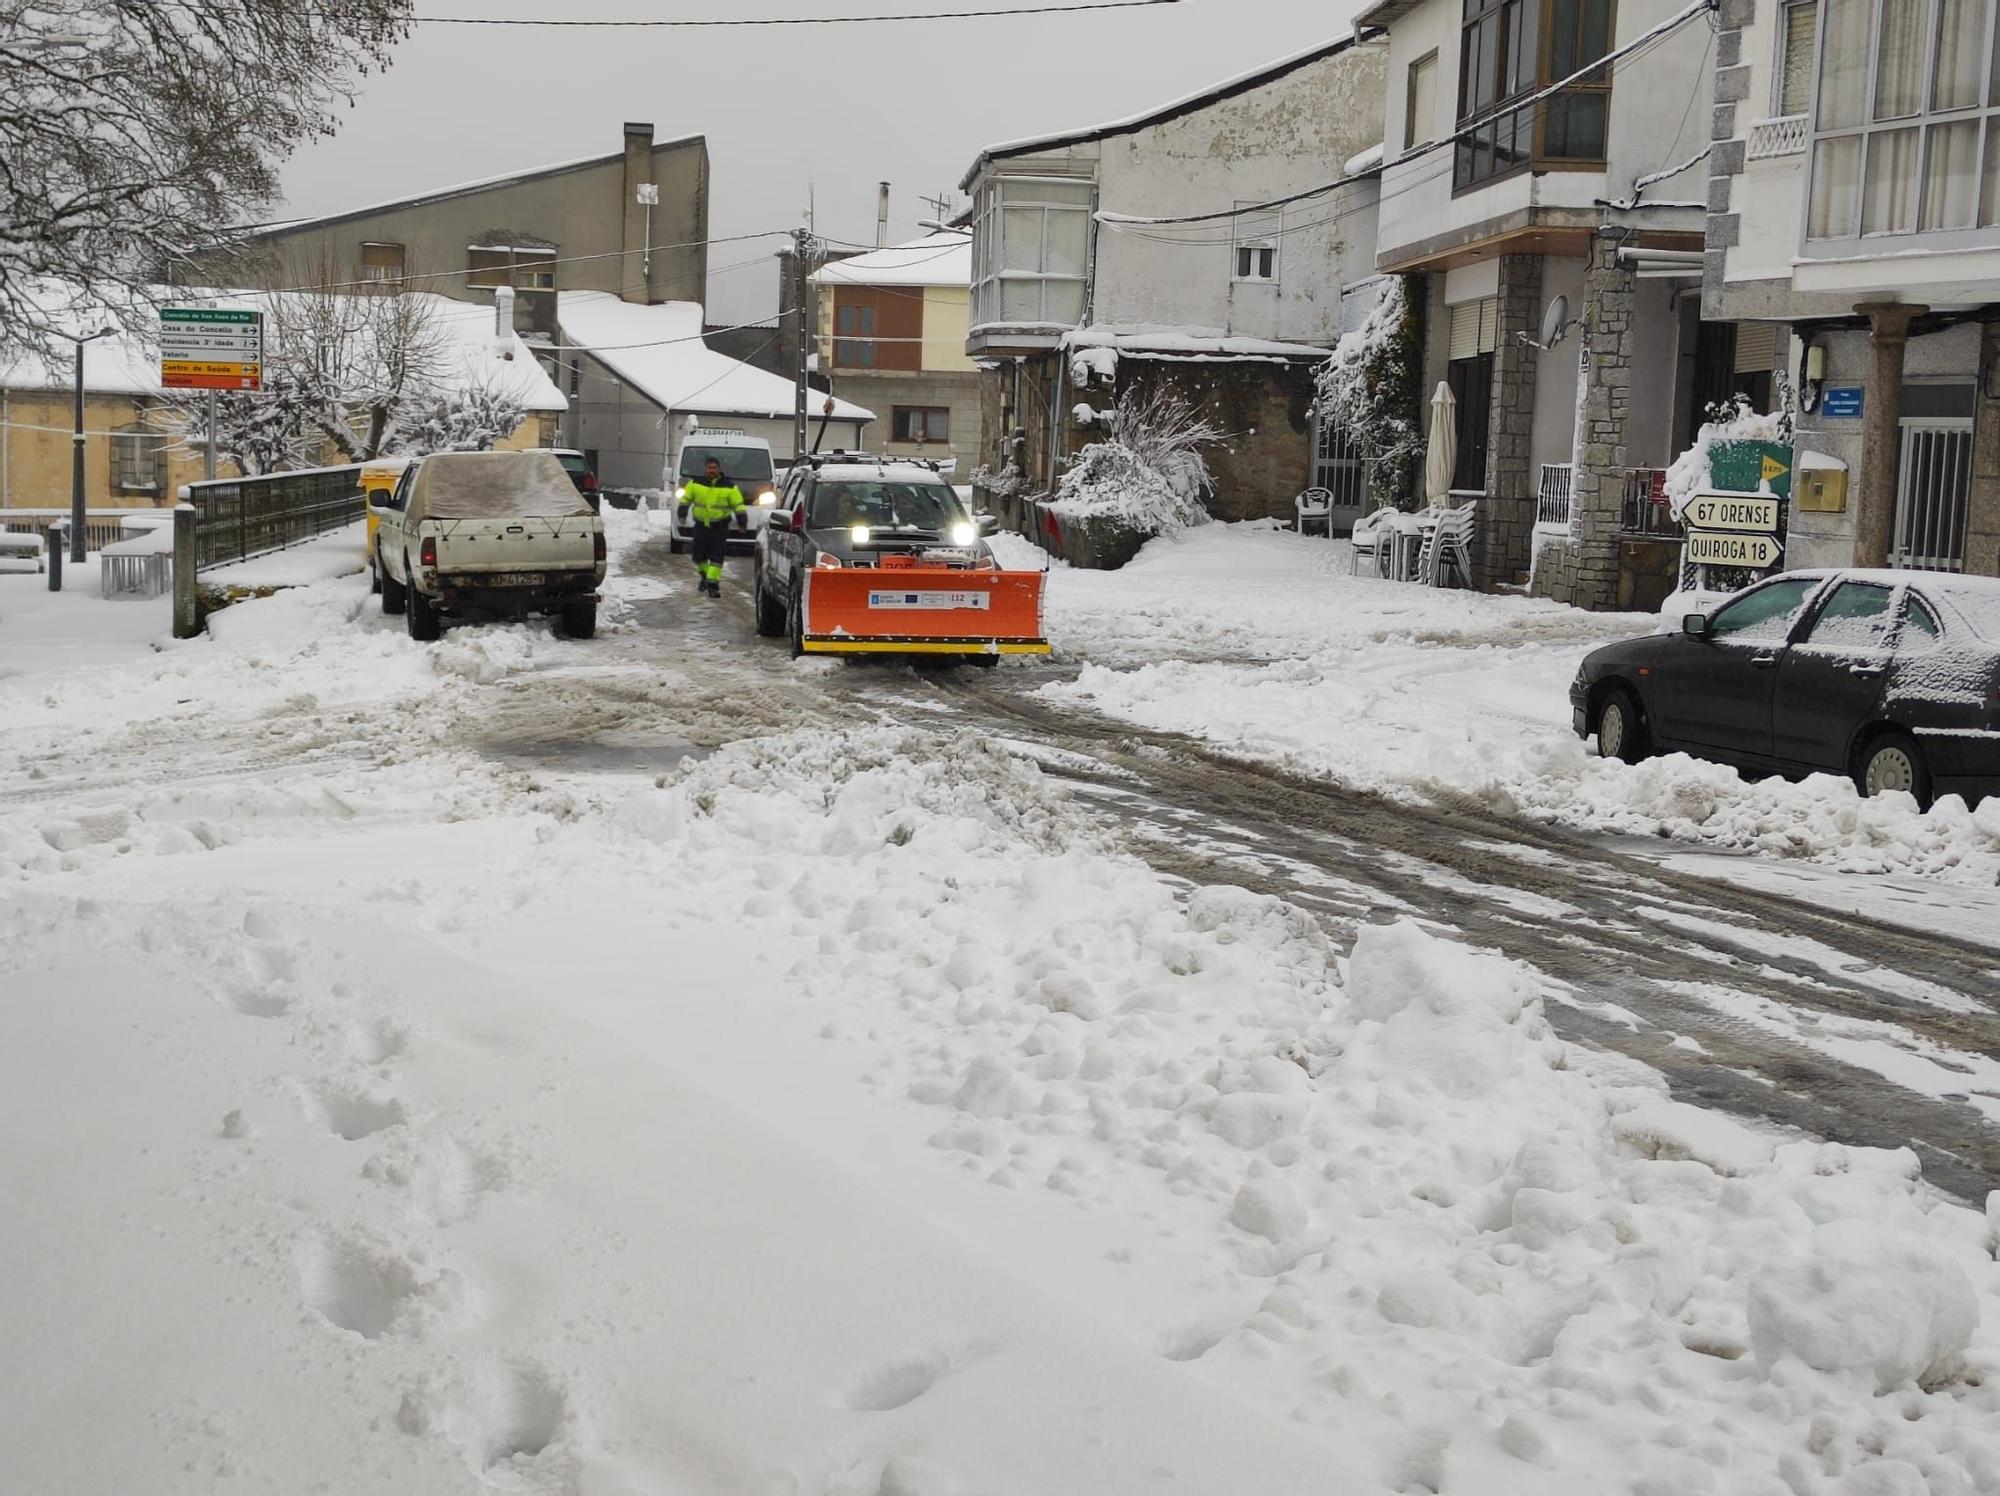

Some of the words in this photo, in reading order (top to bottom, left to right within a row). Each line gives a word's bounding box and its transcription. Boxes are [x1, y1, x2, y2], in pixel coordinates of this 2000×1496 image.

[1698, 503, 1715, 521] 67
[1720, 504, 1771, 524] ORENSE
[1691, 538, 1747, 559] QUIROGA
[1751, 543, 1768, 560] 18
[951, 594, 965, 602] 112
